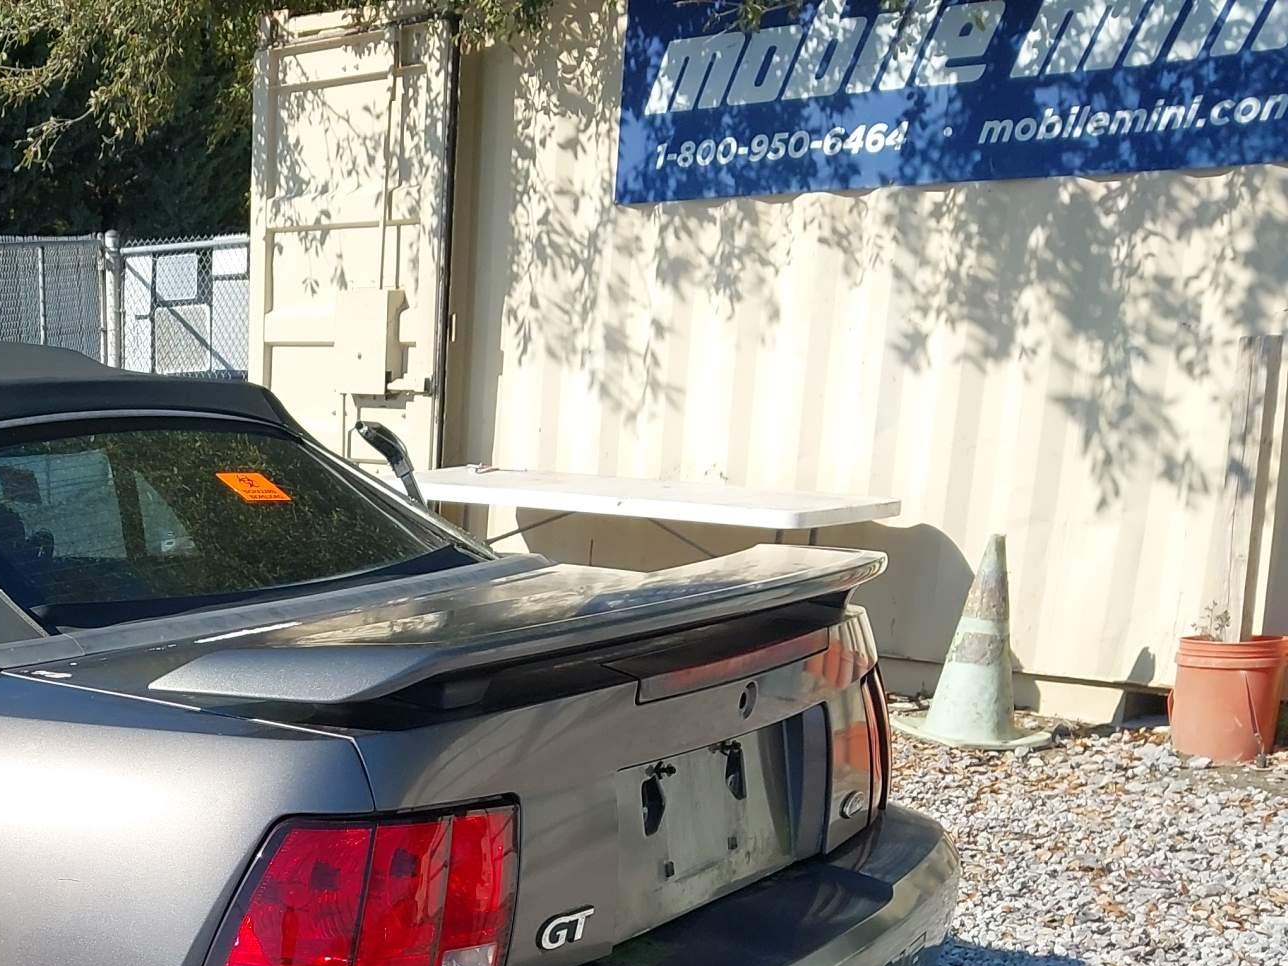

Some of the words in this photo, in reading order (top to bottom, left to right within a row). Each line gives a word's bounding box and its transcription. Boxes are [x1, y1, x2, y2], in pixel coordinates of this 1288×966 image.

[645, 0, 1006, 115] mobile
[655, 121, 910, 170] 1-800-950-6464
[537, 905, 594, 950] GT
